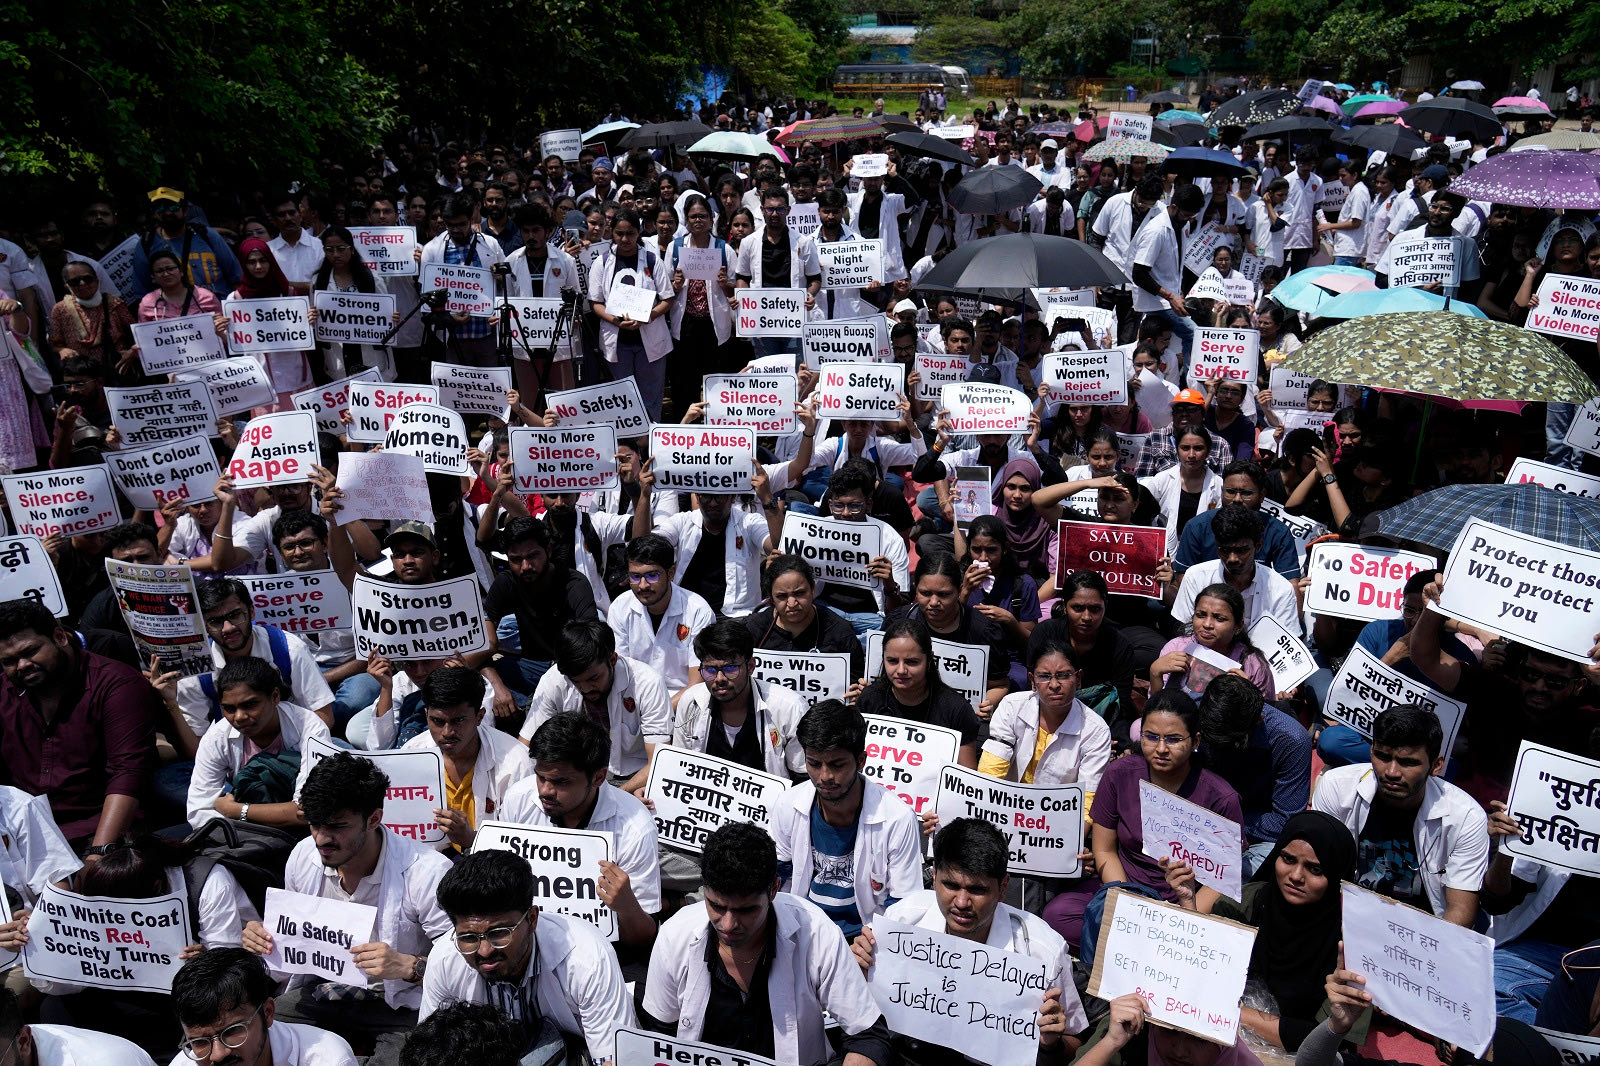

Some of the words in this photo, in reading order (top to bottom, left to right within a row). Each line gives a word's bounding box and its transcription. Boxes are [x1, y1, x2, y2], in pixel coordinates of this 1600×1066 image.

[1113, 118, 1122, 126] No
[1110, 129, 1120, 137] No
[1122, 130, 1147, 140] Service
[800, 215, 817, 225] PAIN
[820, 246, 858, 255] Reclaim
[834, 255, 863, 266] Night
[1394, 253, 1433, 266] राहणार
[437, 268, 454, 277] "No
[458, 270, 480, 278] More
[829, 267, 854, 275] Save
[434, 277, 484, 291] Silence,
[827, 274, 873, 285] Saviours
[1560, 281, 1578, 291] "No
[742, 298, 757, 310] No
[1047, 295, 1059, 304] She
[1061, 294, 1079, 303] Saved
[232, 310, 251, 323] No
[255, 308, 303, 324] Safety,
[1553, 306, 1567, 316] No
[1571, 309, 1599, 321] More
[157, 322, 194, 334] Justice
[741, 317, 756, 328] No
[760, 317, 801, 328] Service
[154, 331, 203, 347] Delayed
[234, 331, 252, 344] No
[256, 329, 306, 344] Service
[318, 326, 351, 339] Strong
[844, 328, 875, 339] Strong
[1202, 331, 1228, 340] Here
[1232, 332, 1246, 340] To
[178, 346, 186, 355] is
[1200, 342, 1245, 354] Serve
[148, 355, 184, 373] Justice
[186, 351, 222, 365] Denied
[1203, 355, 1222, 364] Not
[451, 369, 489, 380] Secure
[930, 371, 956, 381] Stand
[1055, 368, 1110, 380] Women,
[1194, 364, 1249, 379] Suffer
[216, 376, 257, 396] protect
[723, 379, 746, 389] "No
[749, 379, 778, 389] More
[826, 374, 844, 387] No
[849, 373, 895, 392] Safety,
[1065, 381, 1101, 391] Reject
[219, 395, 239, 409] you
[351, 392, 369, 407] No
[456, 391, 495, 401] Secure
[720, 392, 782, 406] Silence,
[959, 394, 1015, 405] Women,
[822, 398, 840, 409] No
[845, 397, 896, 411] Service
[117, 405, 175, 420] राहणार
[558, 405, 577, 419] No
[727, 408, 742, 416] No
[746, 407, 776, 416] More
[319, 419, 338, 430] No
[360, 416, 379, 431] No
[561, 431, 595, 443] More
[654, 431, 698, 450] "Stop
[700, 432, 751, 450] Abuse,
[250, 441, 314, 460] Against
[528, 445, 600, 461] Silence,
[672, 452, 711, 465] Stand
[715, 452, 733, 465] for
[170, 461, 213, 482] Apron
[537, 462, 557, 472] No
[560, 461, 594, 472] More
[48, 474, 85, 488] More
[18, 489, 95, 508] Silence,
[29, 510, 48, 521] No
[51, 505, 89, 518] More
[1089, 530, 1134, 545] SAVE
[1089, 551, 1127, 564] OUR
[1470, 536, 1550, 577] Protect
[252, 581, 294, 591] Here
[299, 576, 320, 586] To
[1467, 559, 1513, 589] Who
[1513, 580, 1594, 613] protect
[143, 593, 168, 603] WANT
[254, 591, 323, 608] Serve
[1325, 583, 1350, 603] No
[134, 604, 166, 614] JUSTICE
[263, 608, 295, 618] Not
[300, 605, 320, 614] To
[1497, 599, 1539, 624] you
[357, 607, 478, 635] Women,
[789, 659, 825, 672] Who
[944, 772, 984, 800] When
[988, 778, 1035, 811] White
[1040, 787, 1078, 812] Coat
[964, 801, 1009, 825] Turns
[1014, 811, 1051, 834] Red,
[1144, 818, 1168, 833] NOT
[1171, 817, 1200, 835] SAFE
[1020, 831, 1064, 849] Turns
[70, 903, 126, 926] White
[130, 908, 179, 927] Coat
[1138, 905, 1166, 923] THEY
[50, 920, 100, 942] Turns
[105, 928, 151, 948] Red,
[277, 915, 296, 936] No
[303, 921, 354, 950] Safety
[44, 936, 110, 965] Society
[119, 946, 171, 965] Turns
[285, 947, 306, 964] No
[312, 951, 345, 976] duty
[888, 931, 962, 969] Justice
[971, 949, 1045, 995] Delayed
[81, 961, 134, 980] Black
[941, 976, 957, 992] is
[889, 982, 960, 1018] Justice
[968, 1001, 1038, 1041] Denied
